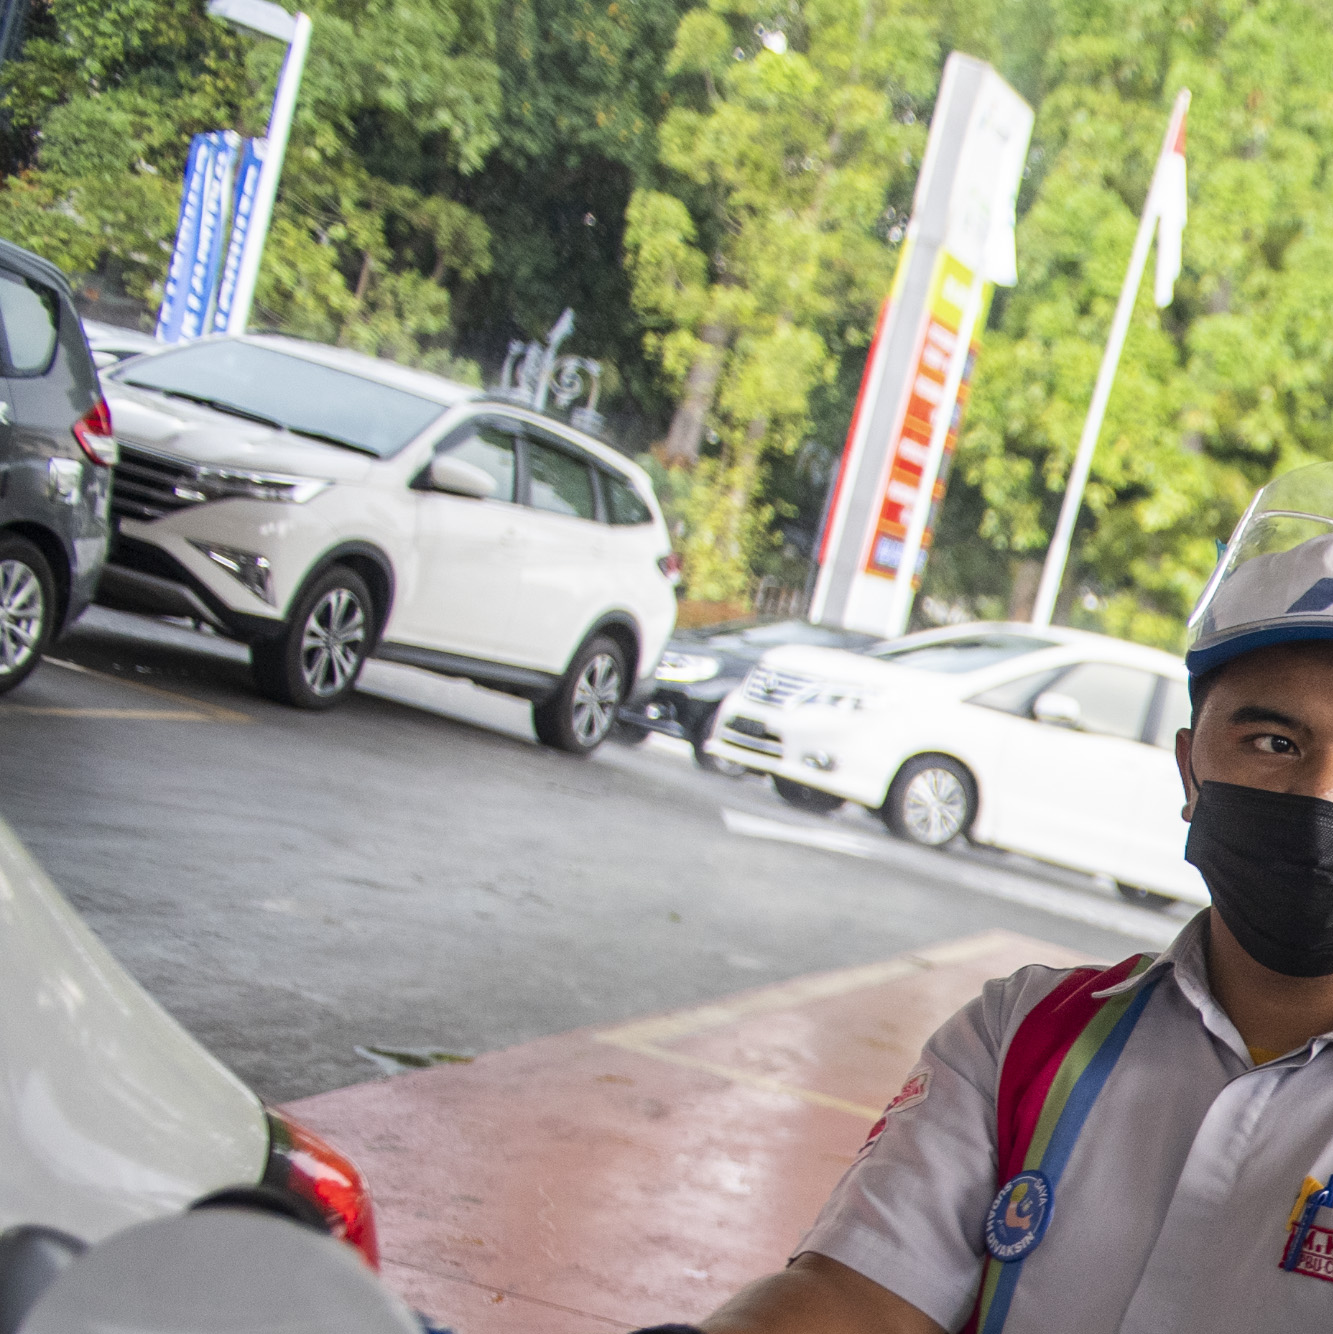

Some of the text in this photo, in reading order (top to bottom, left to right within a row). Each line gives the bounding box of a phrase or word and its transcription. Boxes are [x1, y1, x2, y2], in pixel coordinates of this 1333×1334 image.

[1034, 1178, 1048, 1206] SAYA
[986, 1181, 1035, 1256] SUDAH DIVAKSIN
[1299, 1254, 1322, 1271] PBU
